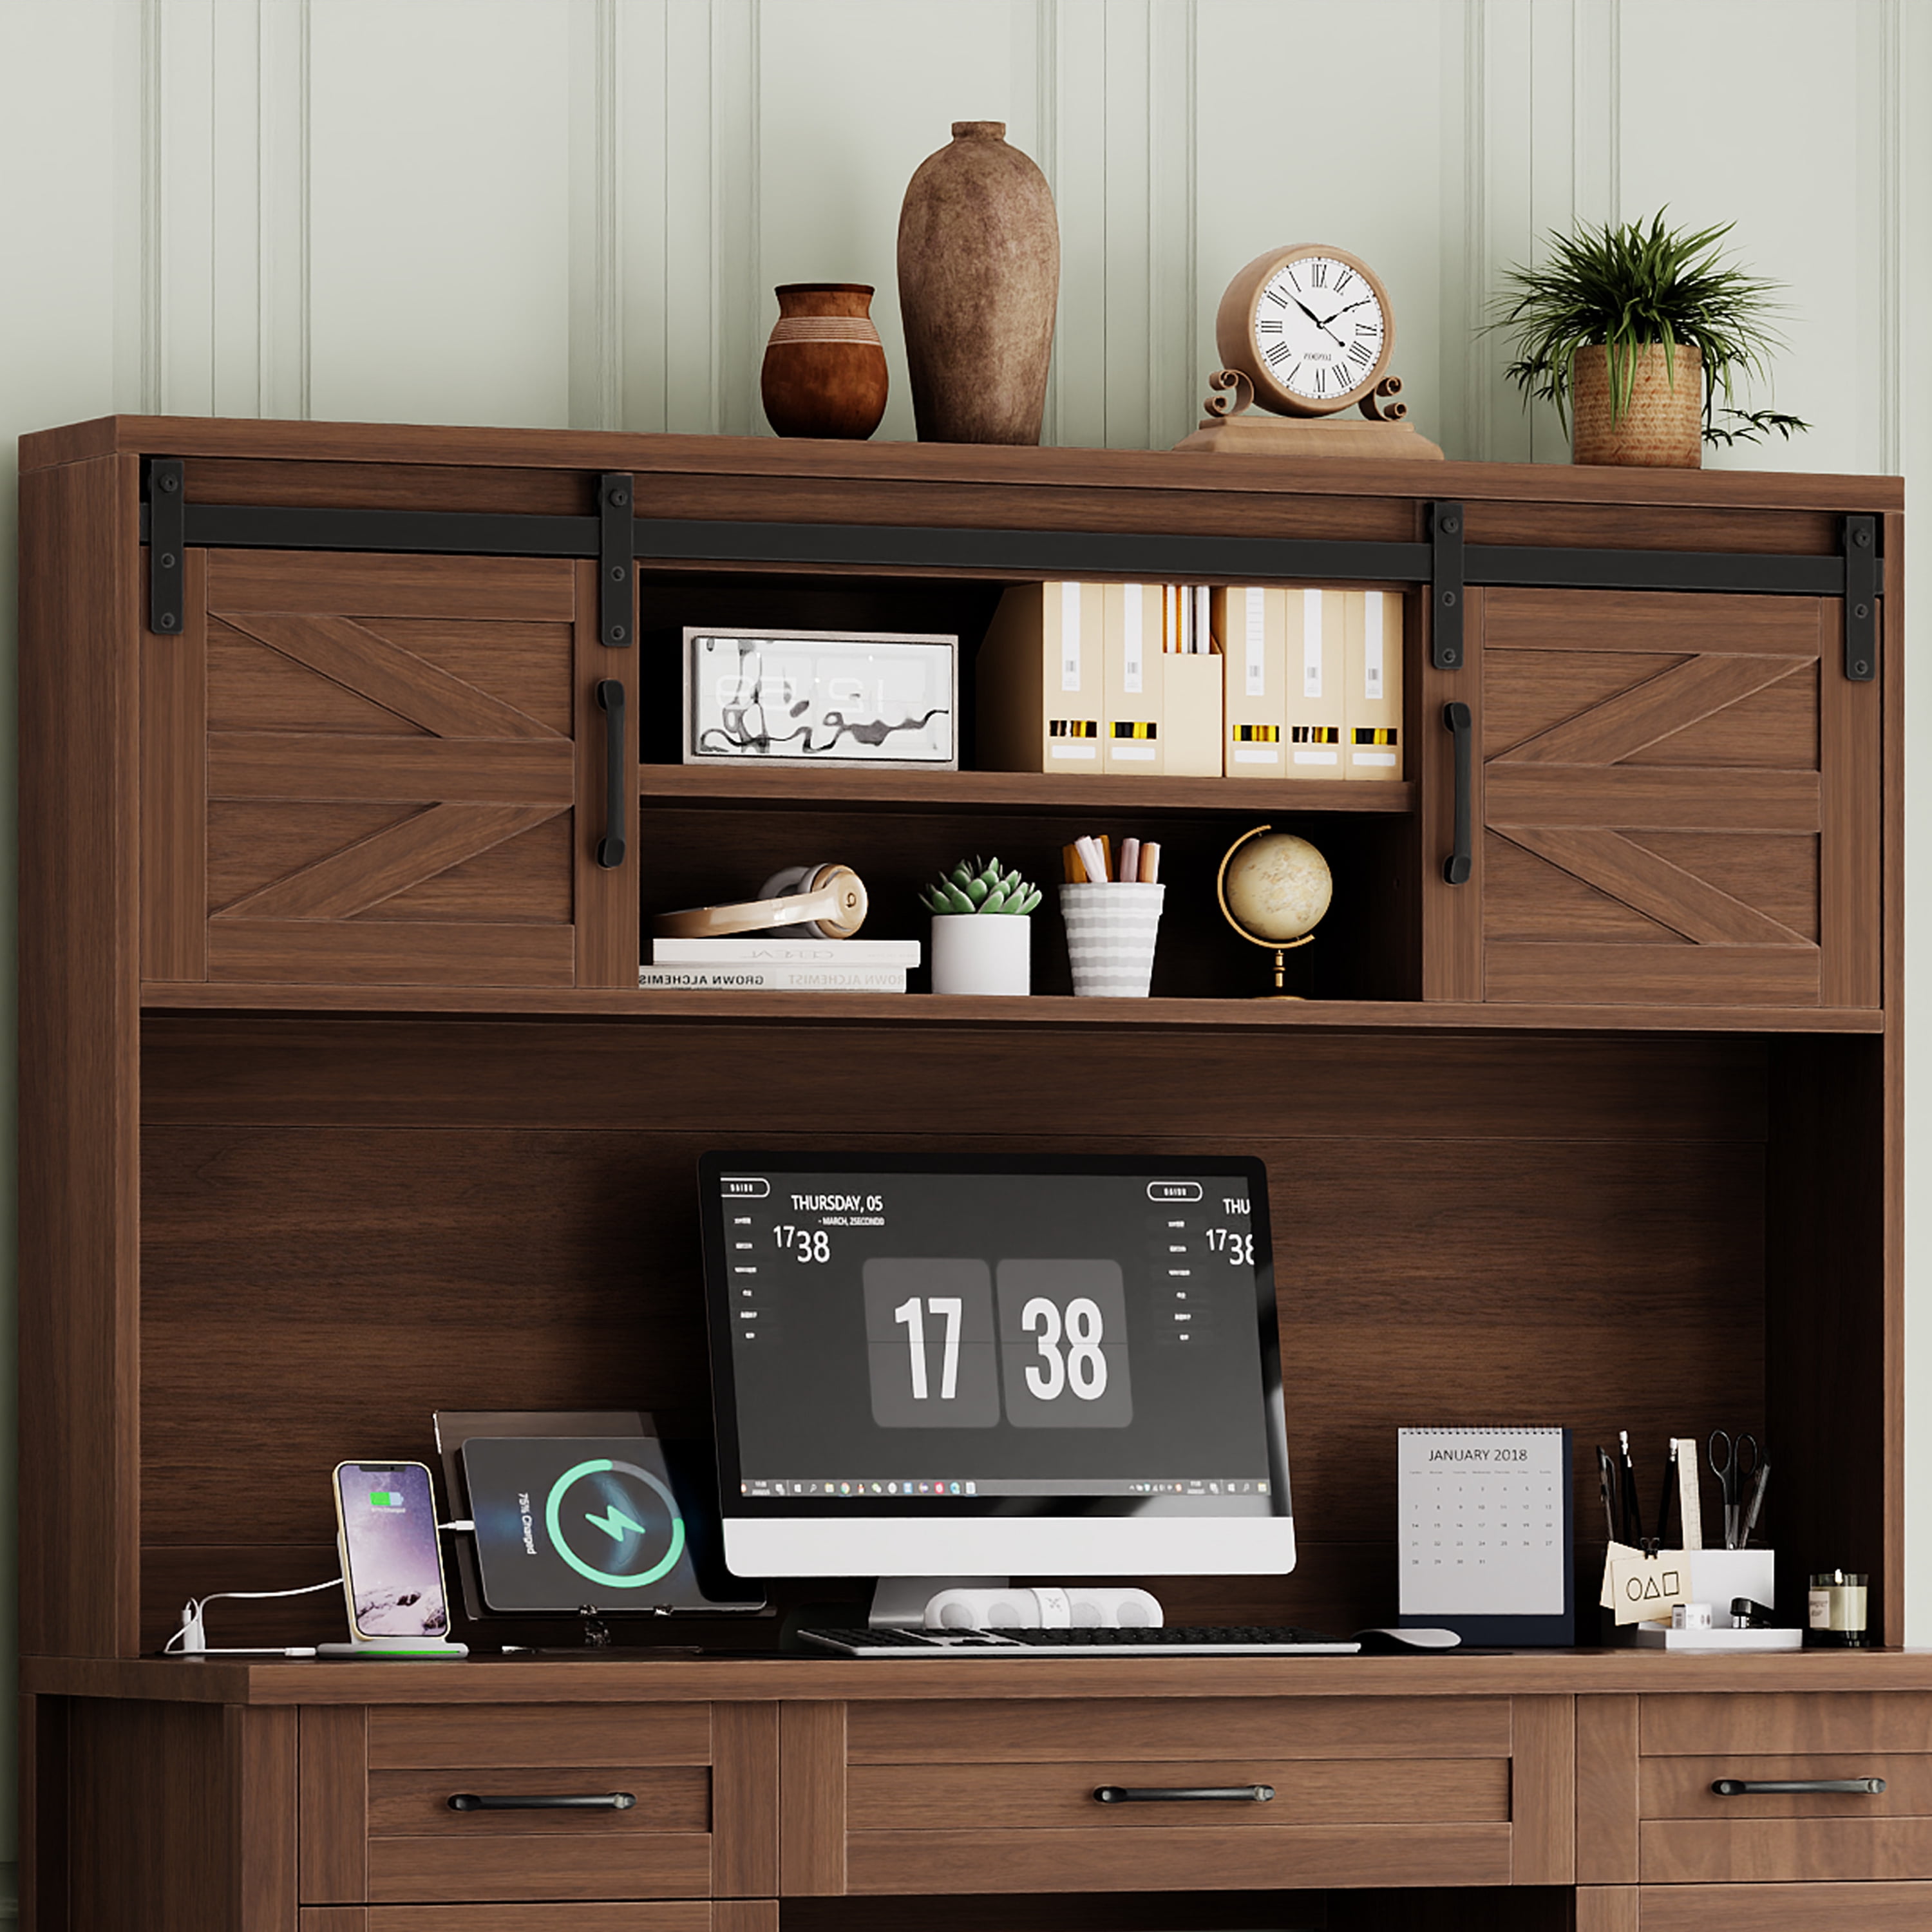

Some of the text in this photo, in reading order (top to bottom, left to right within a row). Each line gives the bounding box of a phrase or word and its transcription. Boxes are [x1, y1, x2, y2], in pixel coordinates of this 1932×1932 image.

[791, 1195, 883, 1213] THURSDAY, 05
[1222, 1198, 1251, 1215] THU
[773, 1226, 830, 1263] 17 38
[1206, 1229, 1227, 1251] 17
[895, 1297, 1108, 1400] 17 38
[1428, 1449, 1528, 1462] JANUARY 2018
